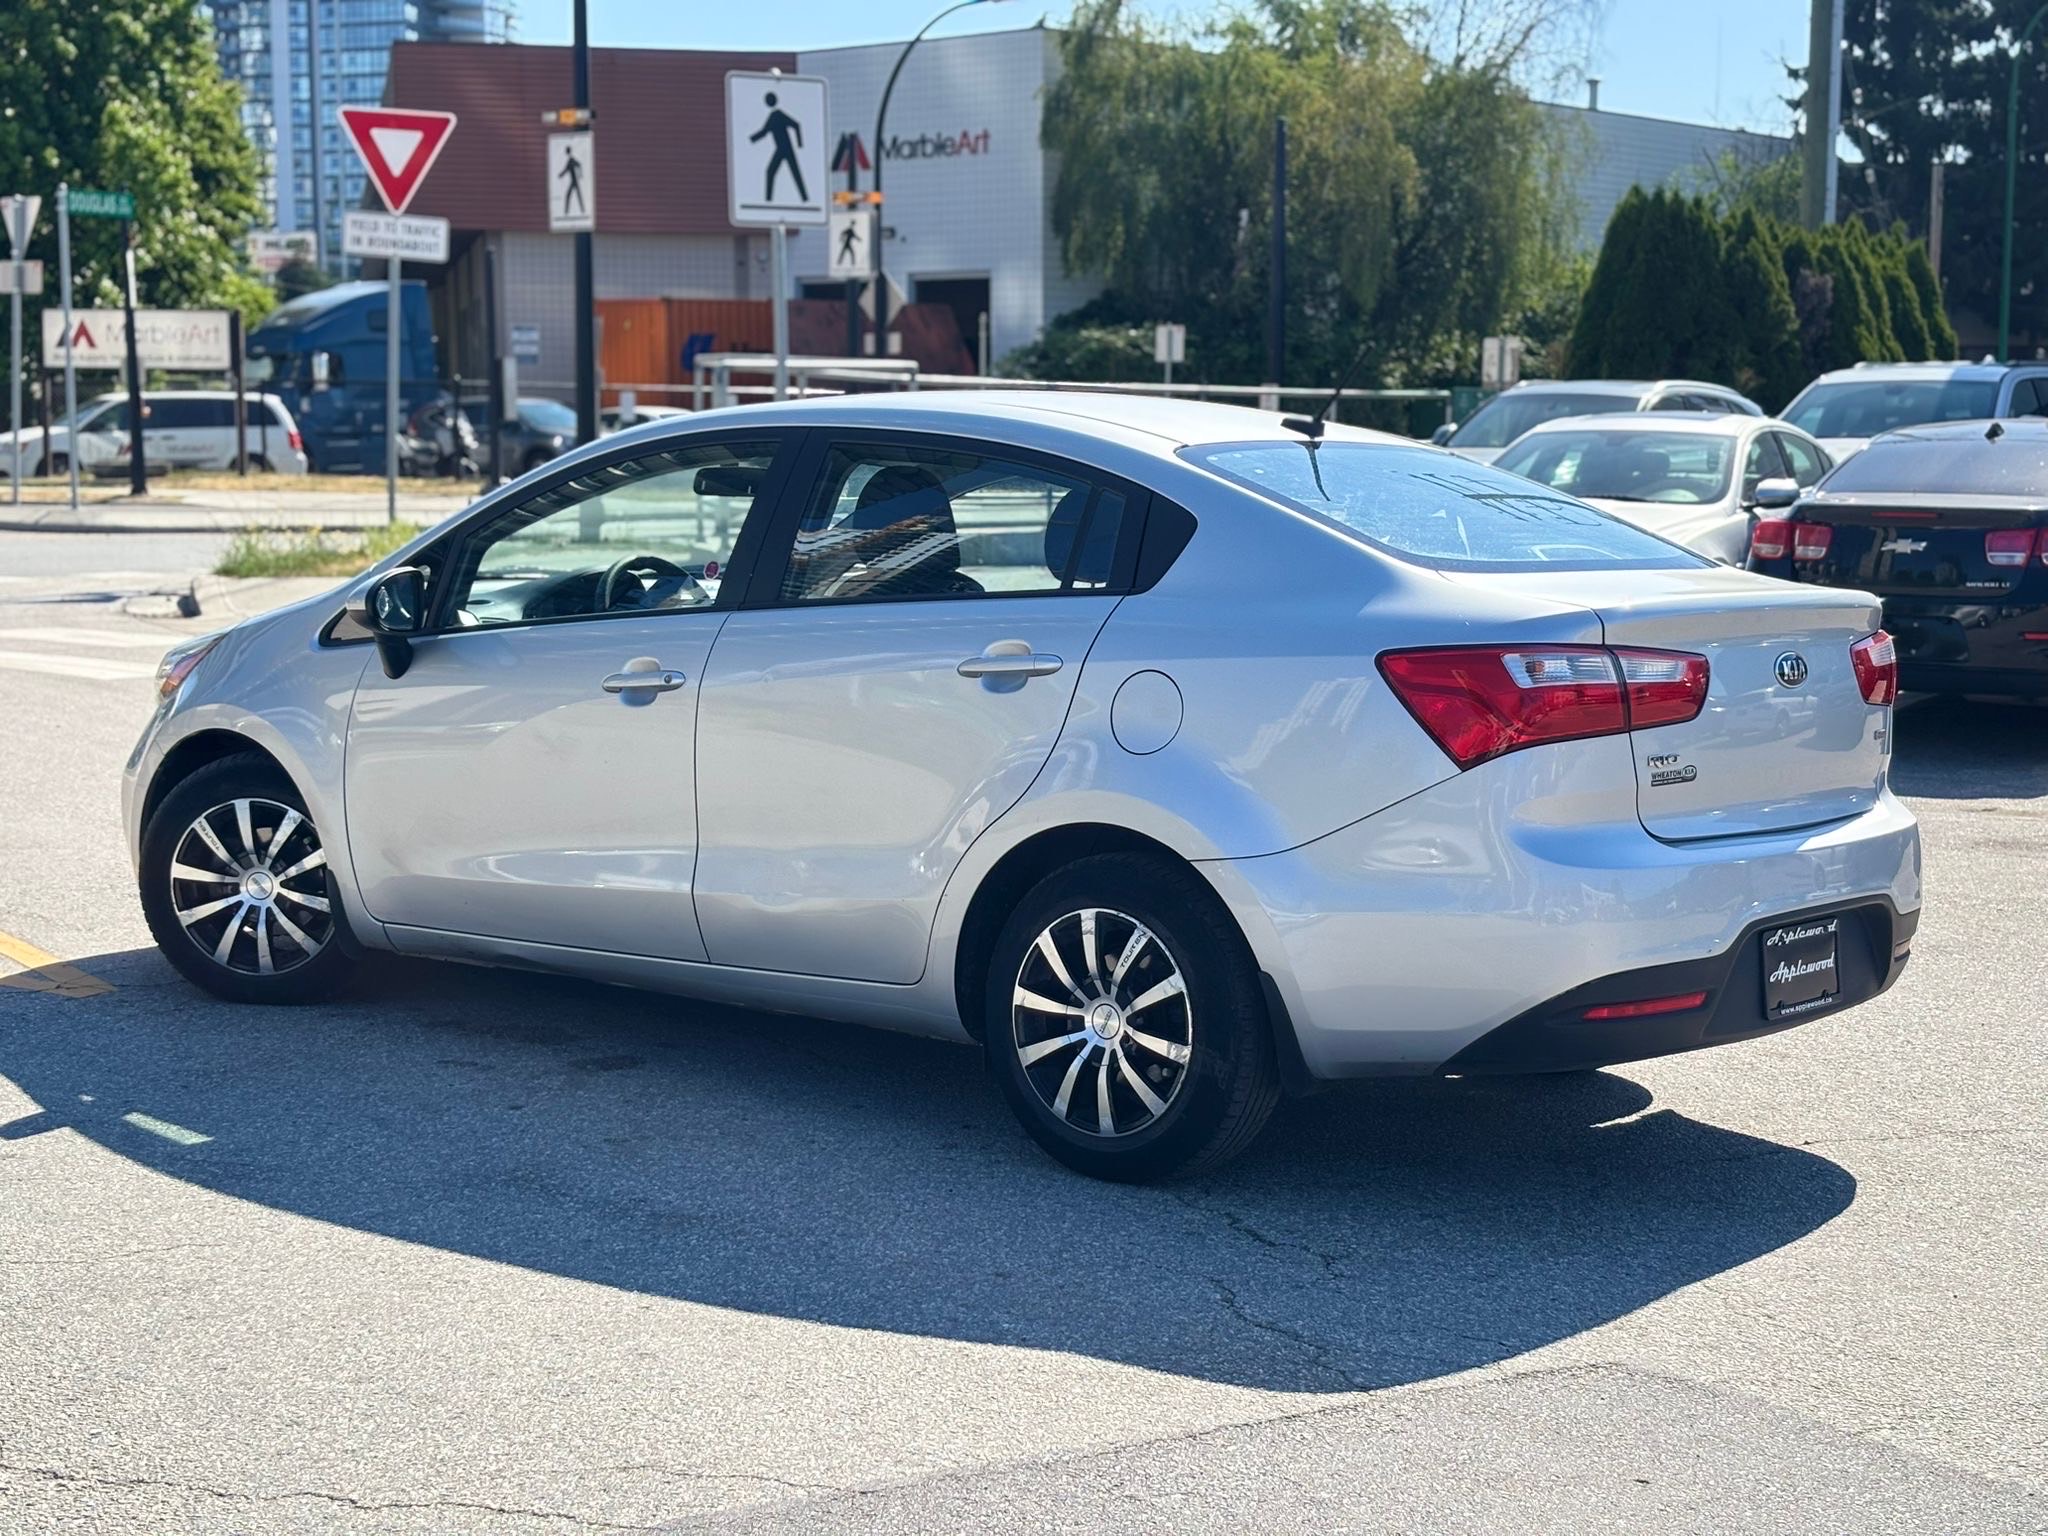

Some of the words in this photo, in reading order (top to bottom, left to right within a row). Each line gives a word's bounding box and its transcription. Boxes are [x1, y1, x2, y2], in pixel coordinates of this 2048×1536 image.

[69, 190, 117, 214] DOUGLAS
[351, 219, 379, 232] YIELD
[384, 222, 398, 234] TO
[401, 223, 441, 237] TRAFFIC
[367, 237, 440, 253] ROUNDABOUT
[1781, 660, 1806, 680] KIA
[1651, 769, 1682, 780] WHEATON
[1684, 768, 1695, 776] KIA
[1769, 951, 1835, 984] Applewood
[1780, 997, 1833, 1015] www.applewood.ca
